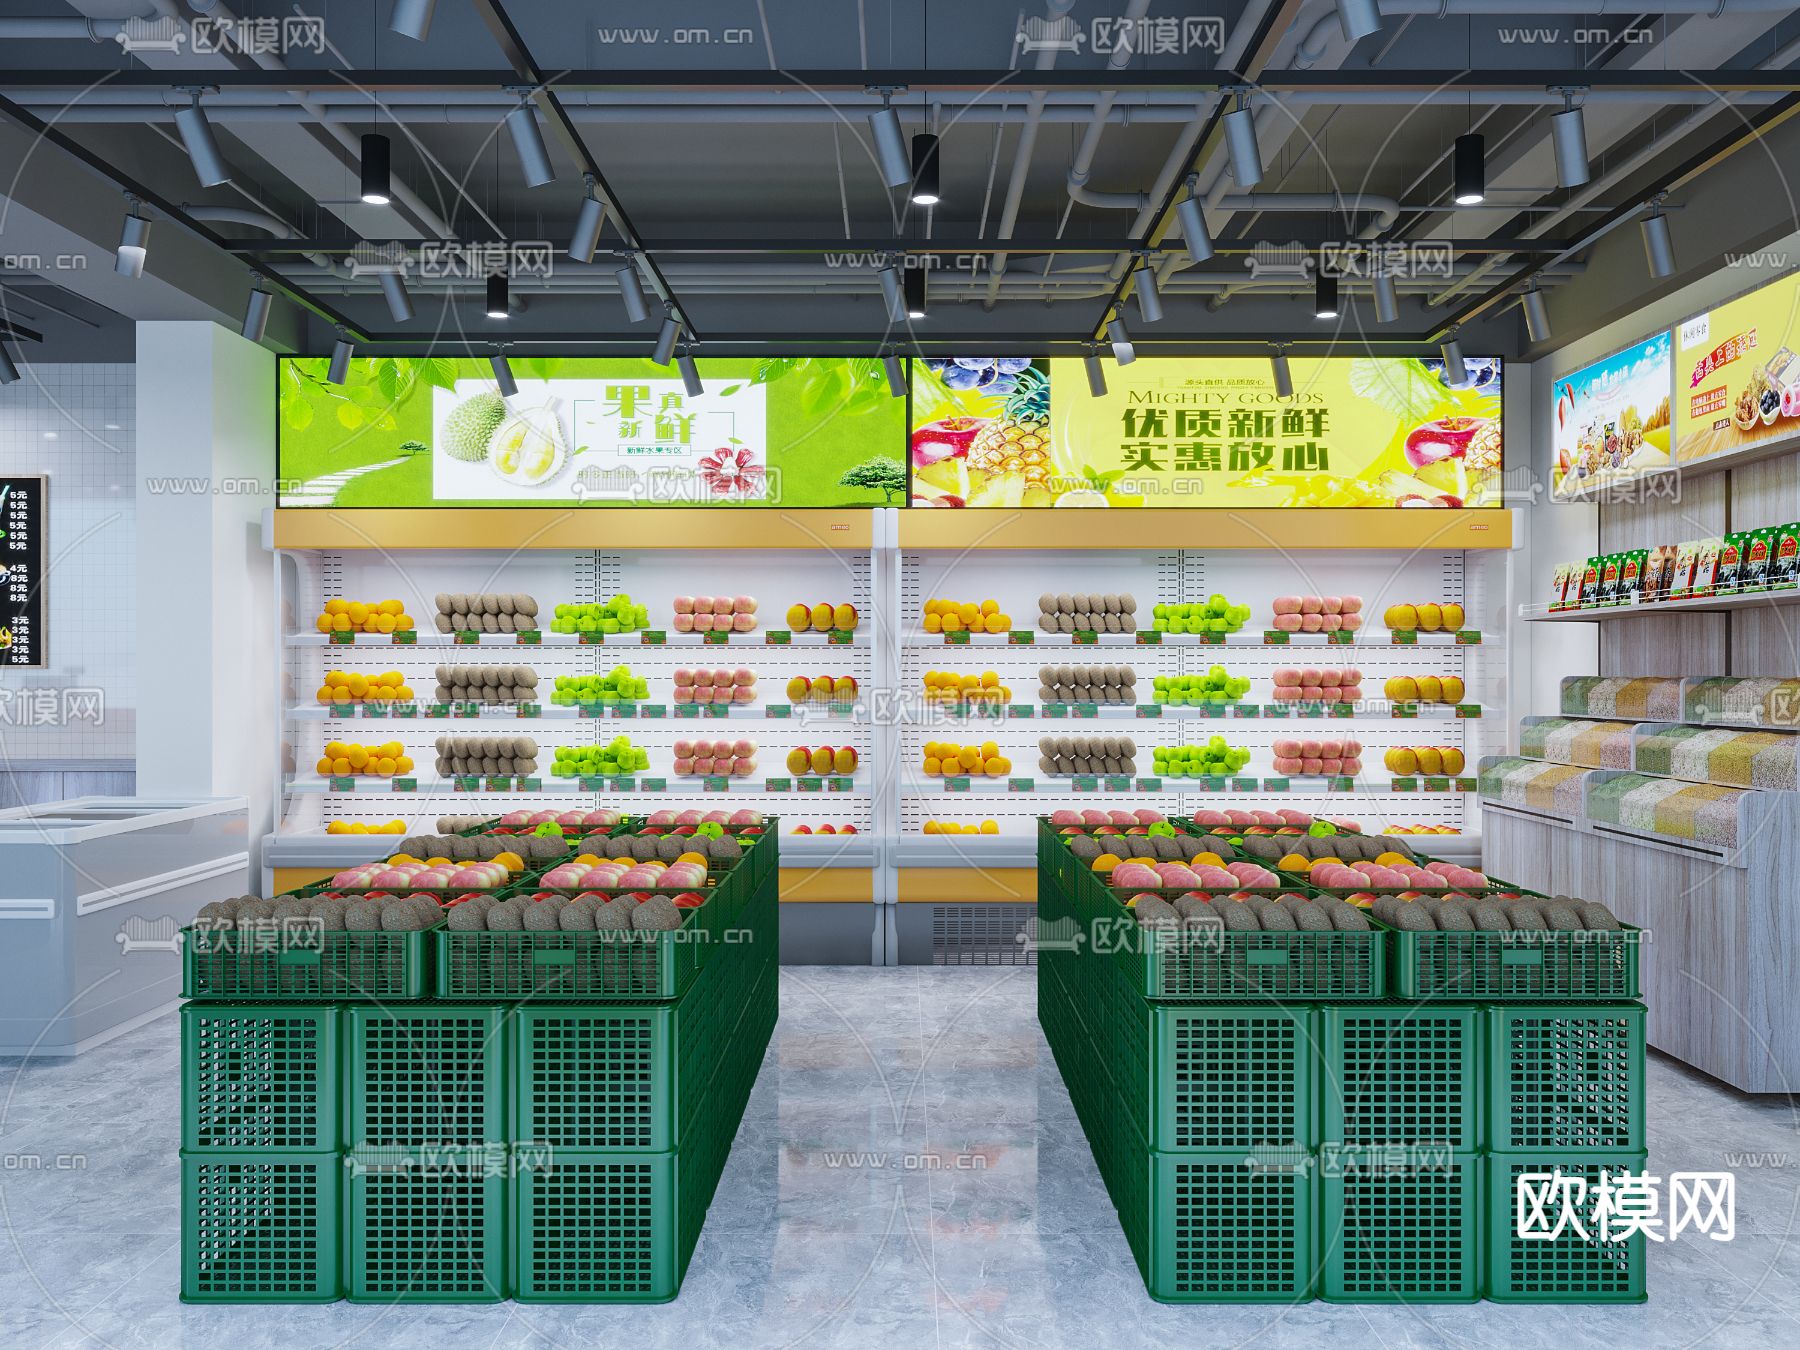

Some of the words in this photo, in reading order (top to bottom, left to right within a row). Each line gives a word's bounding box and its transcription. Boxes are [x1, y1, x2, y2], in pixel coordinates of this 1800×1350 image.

[1128, 390, 1231, 405] MIGHTY
[1120, 408, 1330, 438] 优质新鲜
[626, 446, 682, 455] 新鲜水果专区
[1120, 441, 1329, 472] 实惠放心
[10, 491, 28, 500] 5元
[10, 501, 28, 510] 5元
[10, 511, 28, 520] 5元
[9, 521, 27, 530] 5元
[10, 531, 28, 540] 5元
[9, 541, 27, 550] 5元
[10, 564, 28, 573] 4元
[10, 574, 28, 583] 8元
[10, 584, 28, 593] 8元
[10, 594, 28, 602] 8元
[12, 616, 30, 625] 3元
[12, 626, 30, 635] 3元
[12, 636, 30, 644] 3元
[12, 645, 30, 654] 3元
[12, 655, 30, 664] 5元
